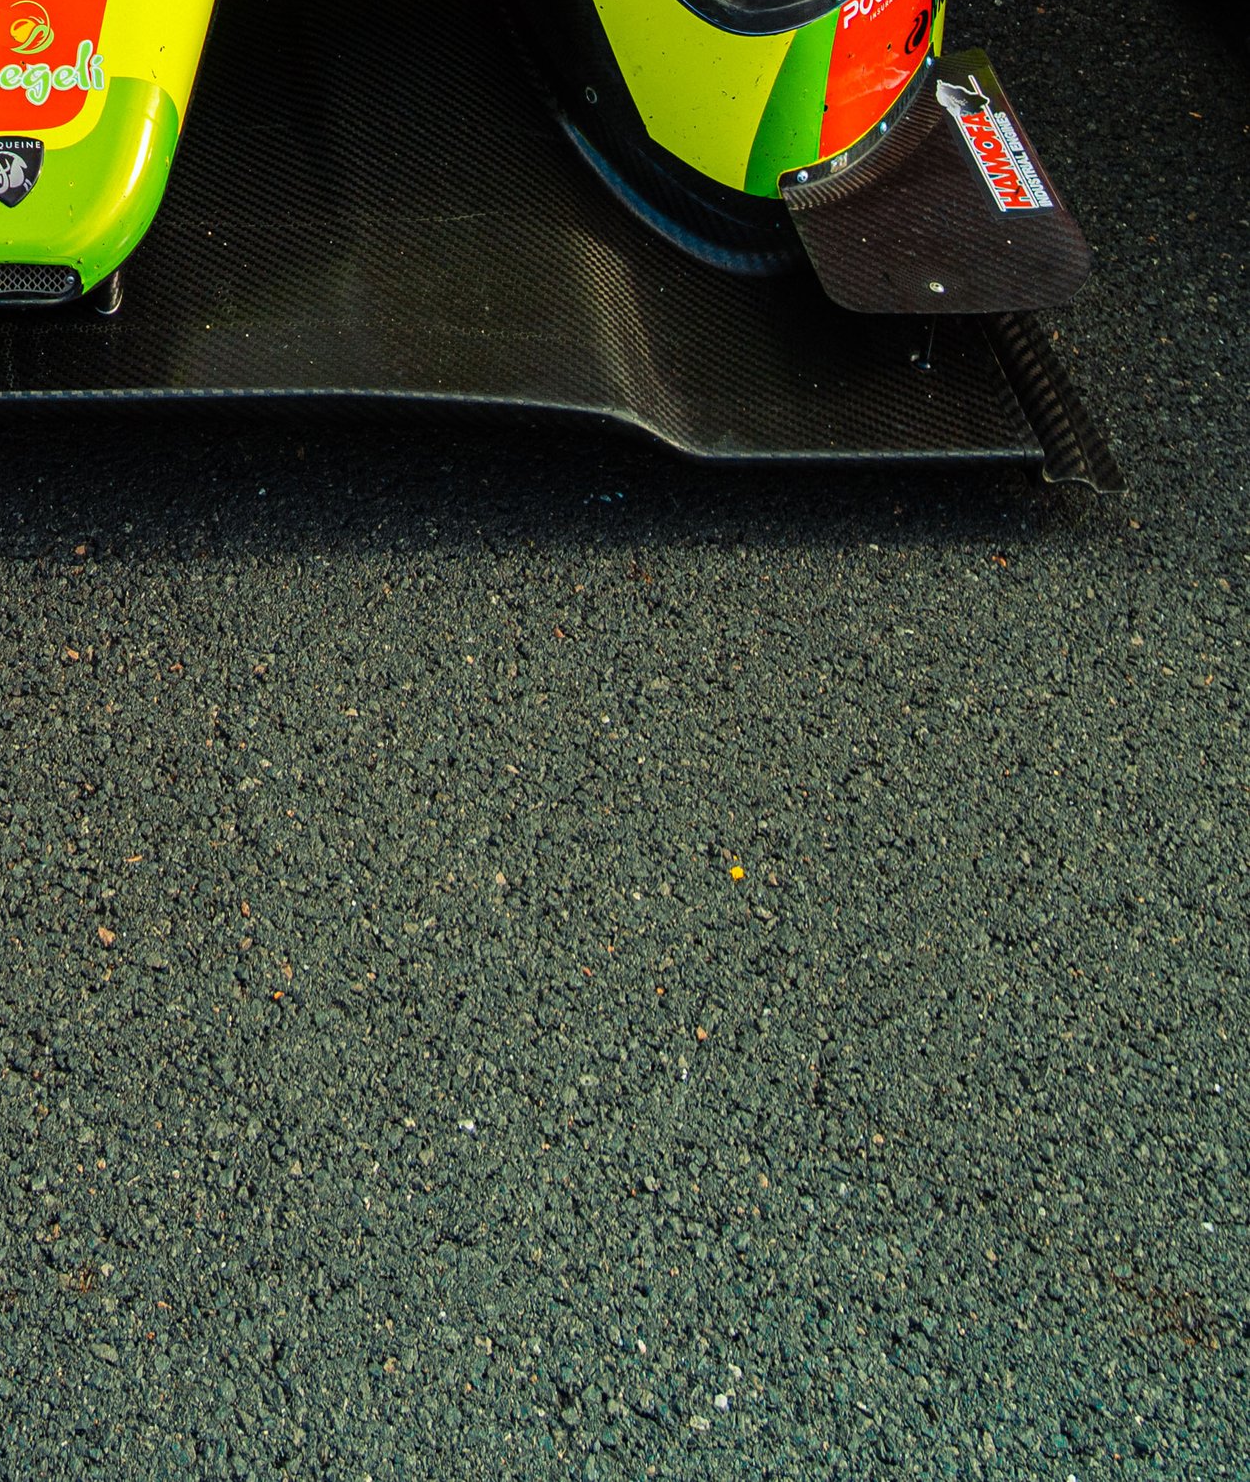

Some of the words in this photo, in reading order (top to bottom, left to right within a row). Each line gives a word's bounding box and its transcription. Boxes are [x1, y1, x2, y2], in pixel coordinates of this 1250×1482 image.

[960, 110, 1033, 208] HAMOFA
[994, 111, 1024, 152] ENGINES
[1016, 151, 1054, 208] INDUSTRIAL
